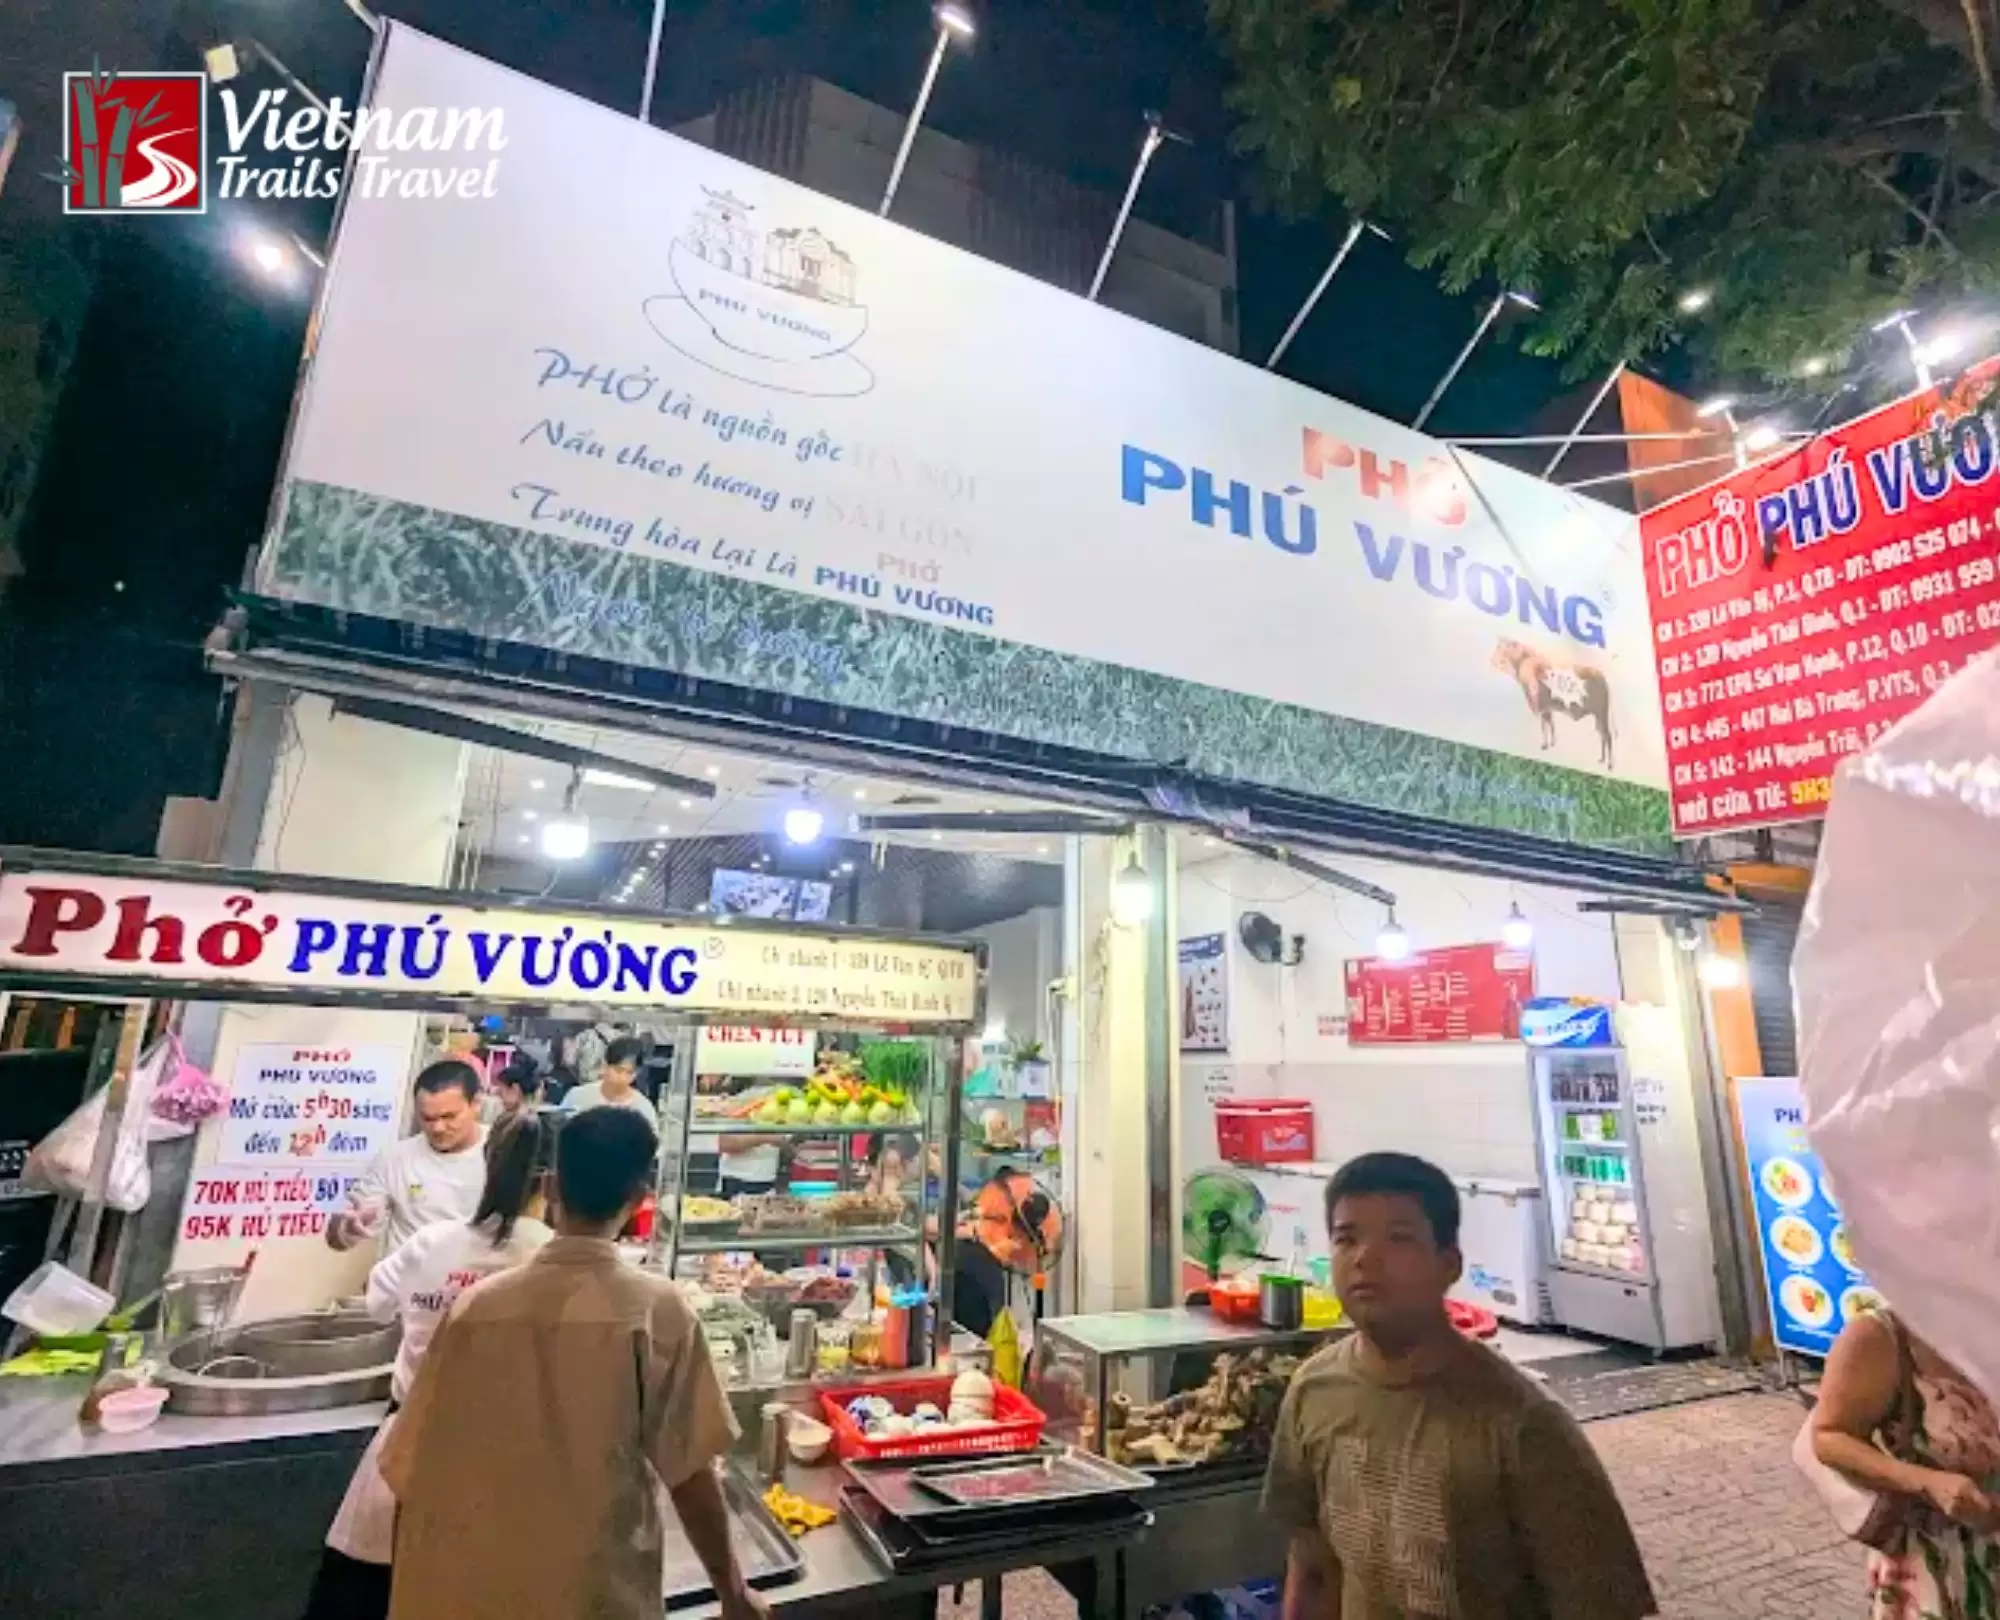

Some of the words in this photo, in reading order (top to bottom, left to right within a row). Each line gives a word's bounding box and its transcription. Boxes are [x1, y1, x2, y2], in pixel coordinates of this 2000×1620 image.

[510, 482, 634, 547] Trung
[893, 582, 994, 626] VƯƠNG
[1121, 443, 1318, 557] PHÚ
[1352, 520, 1607, 649] VƯƠNG
[1655, 488, 1749, 599] PHỞ
[1754, 444, 1863, 551] PHÚ
[1865, 408, 2000, 515] VƯƠ
[10, 886, 279, 968] Phở
[286, 913, 453, 980] PHÚ
[467, 925, 700, 996] VƯƠNG
[1774, 1107, 1802, 1123] PH
[184, 1214, 233, 1241] 95K
[194, 1179, 240, 1205] 70K
